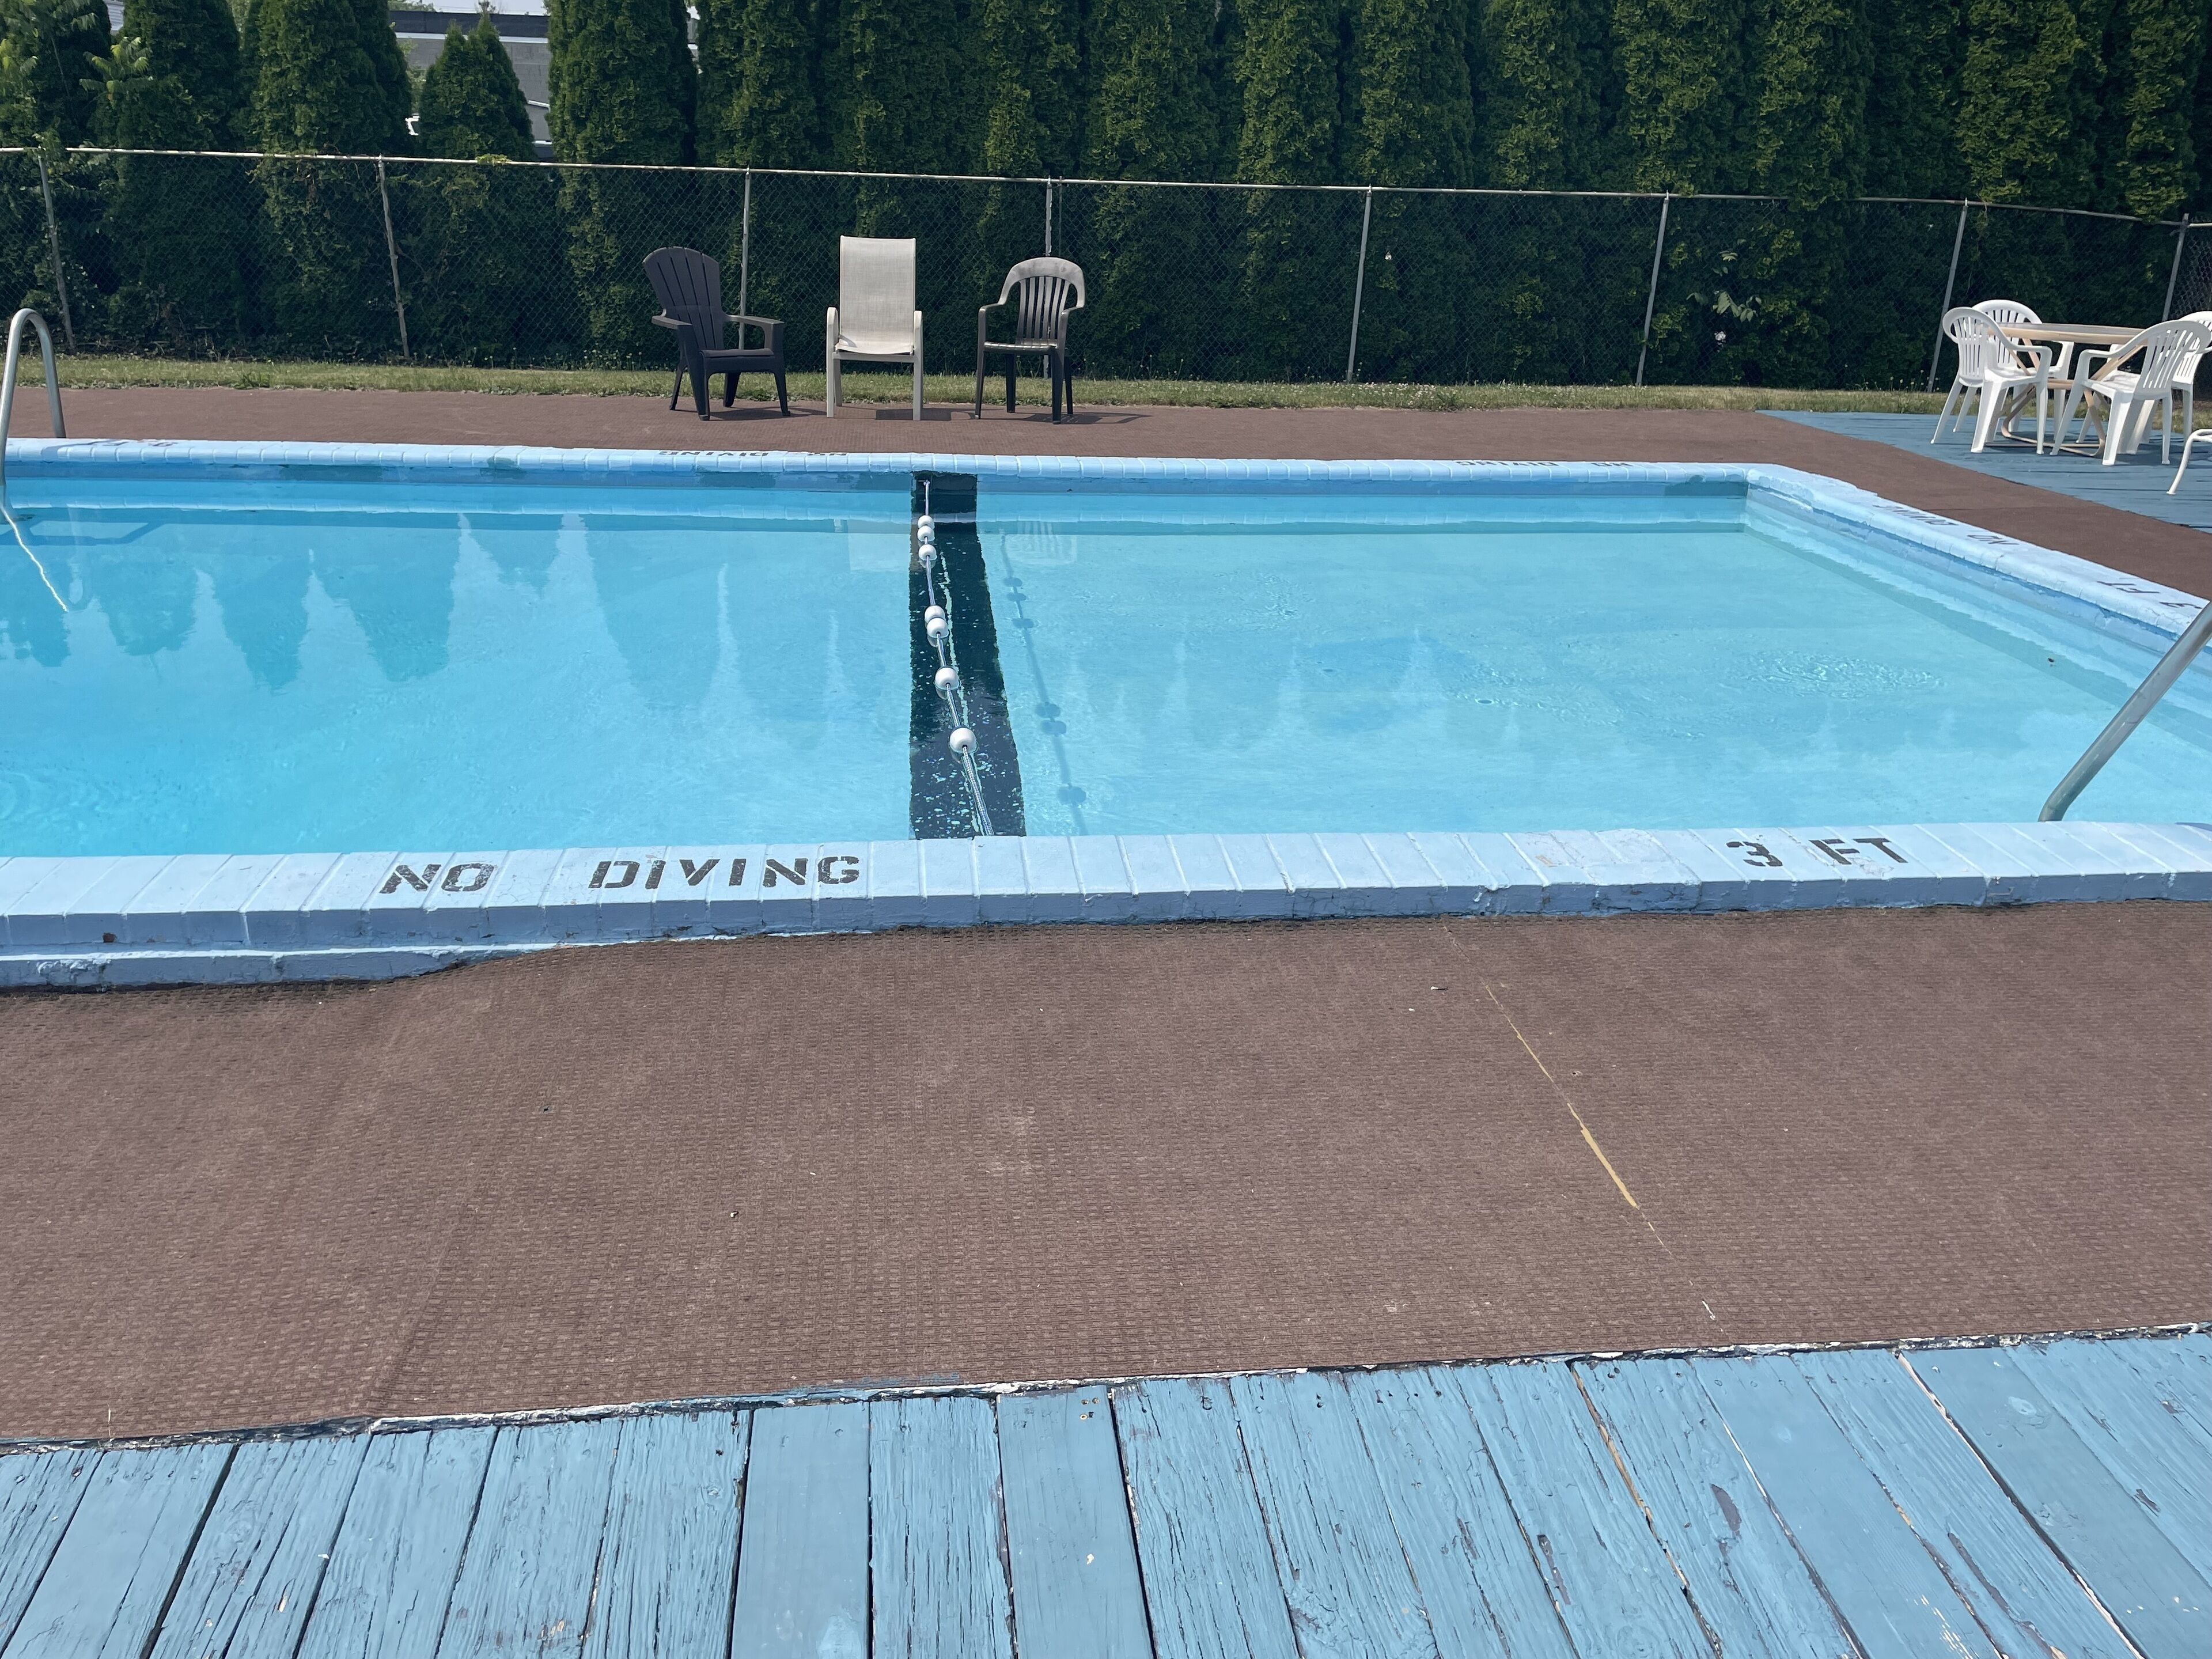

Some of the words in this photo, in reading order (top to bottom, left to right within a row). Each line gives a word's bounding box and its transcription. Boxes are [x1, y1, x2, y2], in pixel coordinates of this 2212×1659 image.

[1726, 840, 1783, 867] 3
[1808, 838, 1909, 865] FT
[379, 862, 495, 894] NO
[588, 855, 860, 890] DIVING
